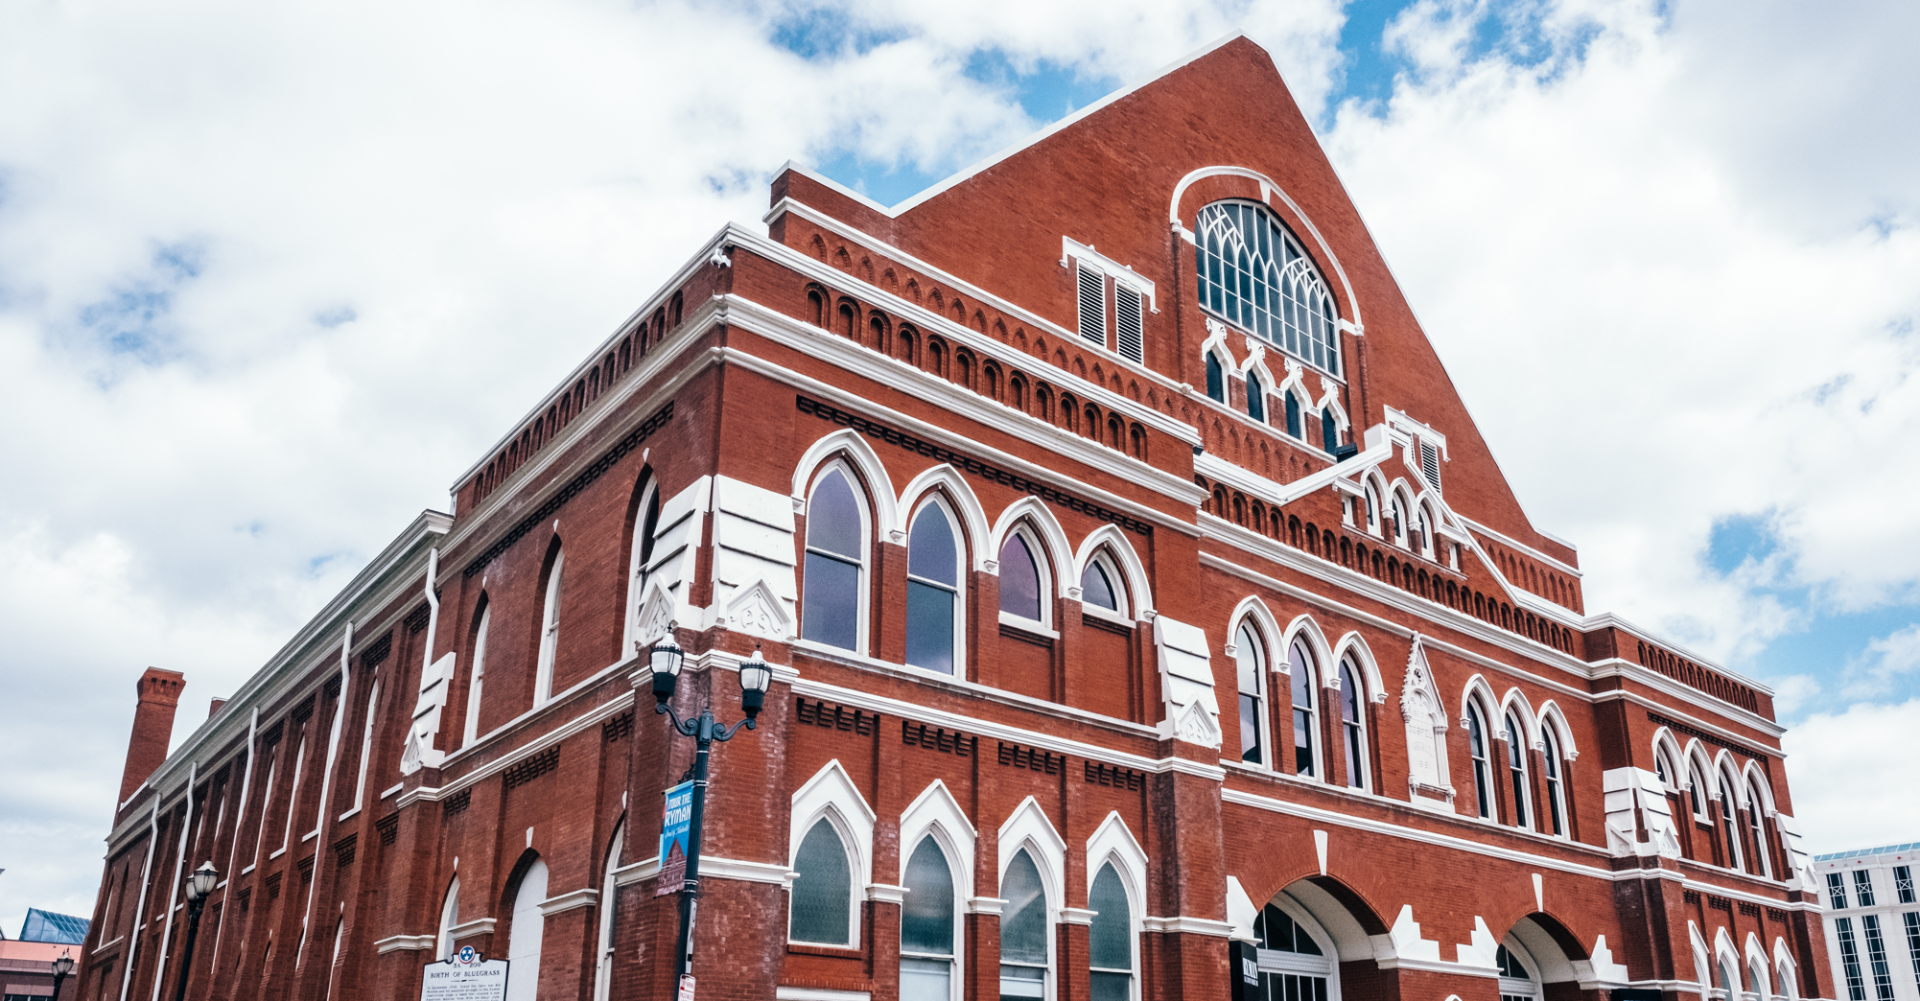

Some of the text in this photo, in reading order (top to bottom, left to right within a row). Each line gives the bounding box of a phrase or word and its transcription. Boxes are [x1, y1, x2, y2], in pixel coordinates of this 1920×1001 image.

[668, 792, 692, 809] TOUR THE
[664, 804, 692, 827] RYMAN
